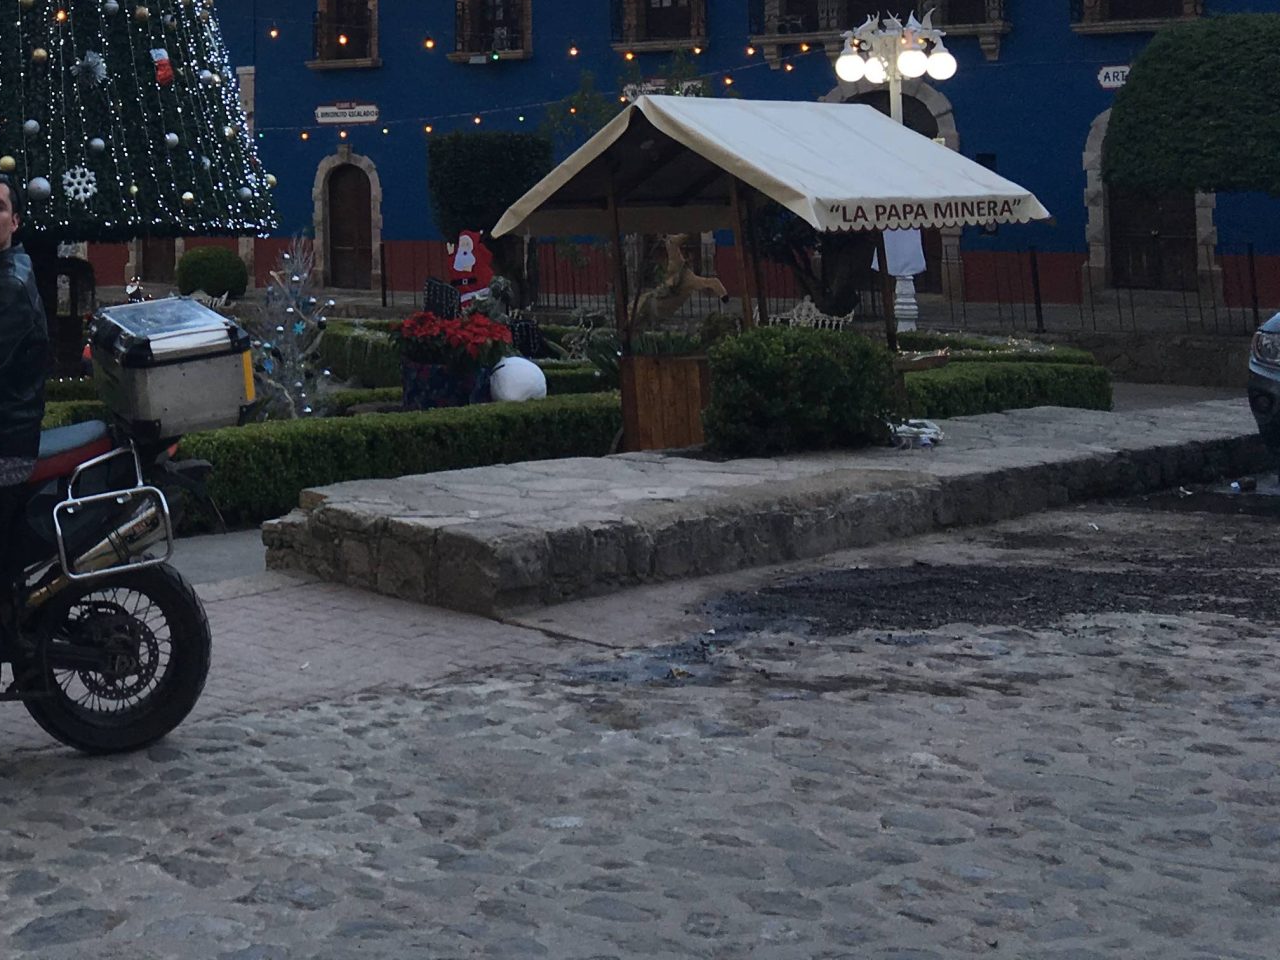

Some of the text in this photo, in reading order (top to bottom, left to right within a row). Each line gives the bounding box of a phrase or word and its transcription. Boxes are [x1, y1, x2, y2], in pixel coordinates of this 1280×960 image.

[1103, 70, 1126, 82] ART
[874, 203, 929, 221] PAPA
[932, 199, 1022, 219] MINERA"
